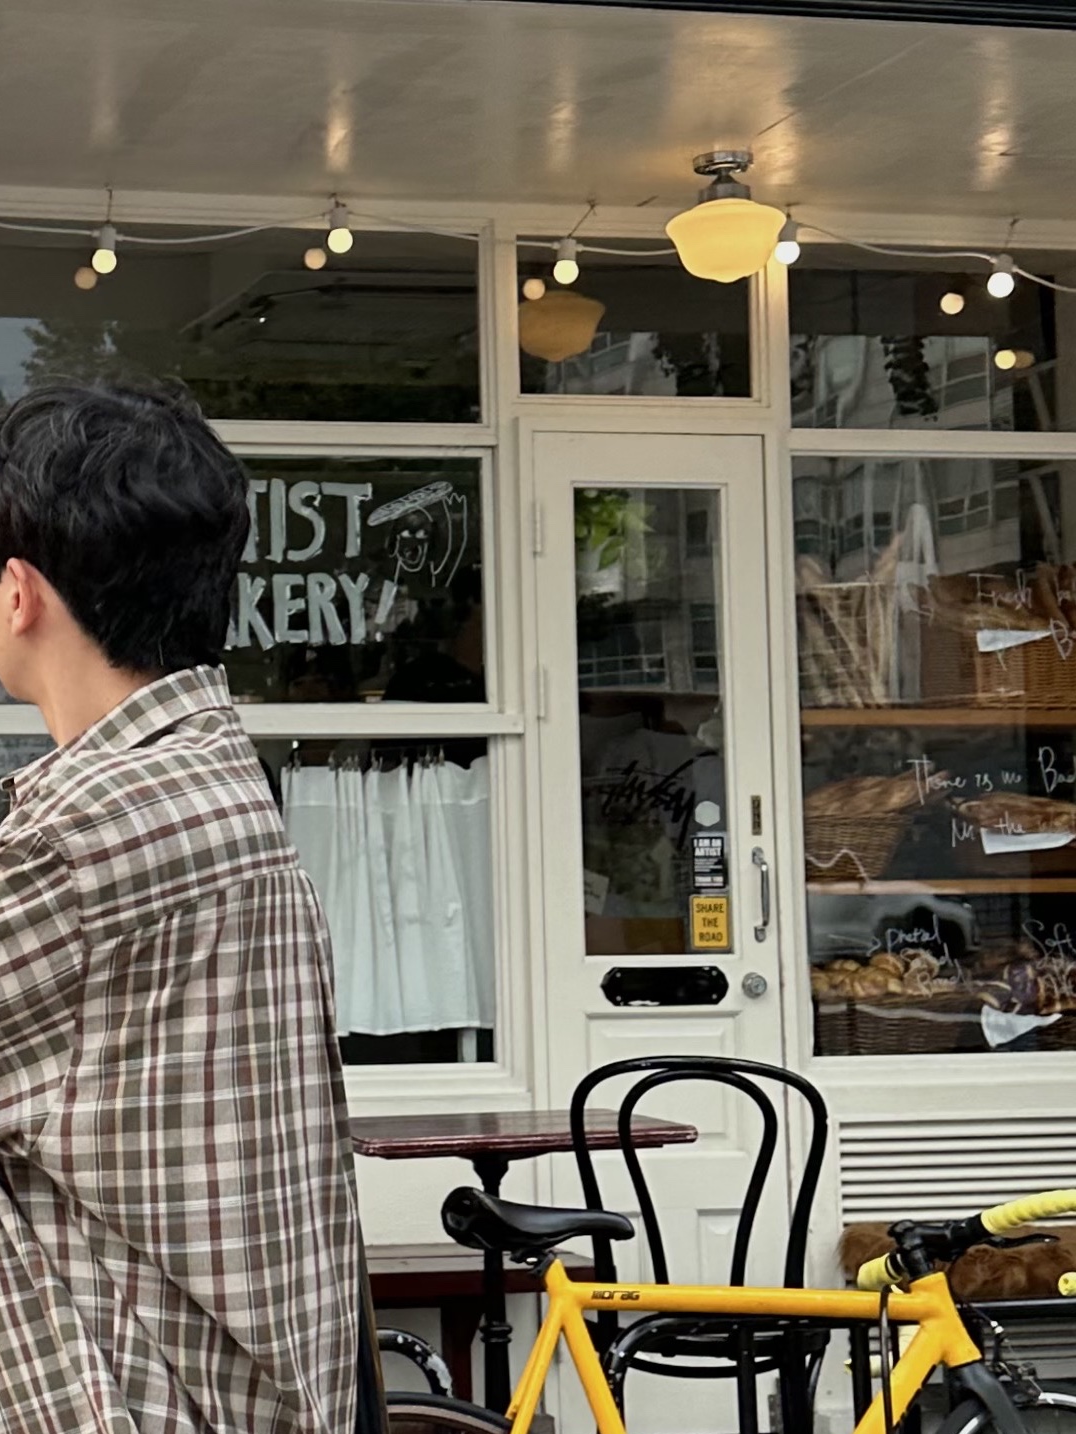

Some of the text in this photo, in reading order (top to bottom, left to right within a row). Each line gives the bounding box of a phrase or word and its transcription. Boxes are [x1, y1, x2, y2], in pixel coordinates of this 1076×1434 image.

[223, 572, 397, 651] KERY!
[695, 903, 724, 913] SHARE
[702, 917, 719, 928] THE
[698, 931, 723, 942] ROAD
